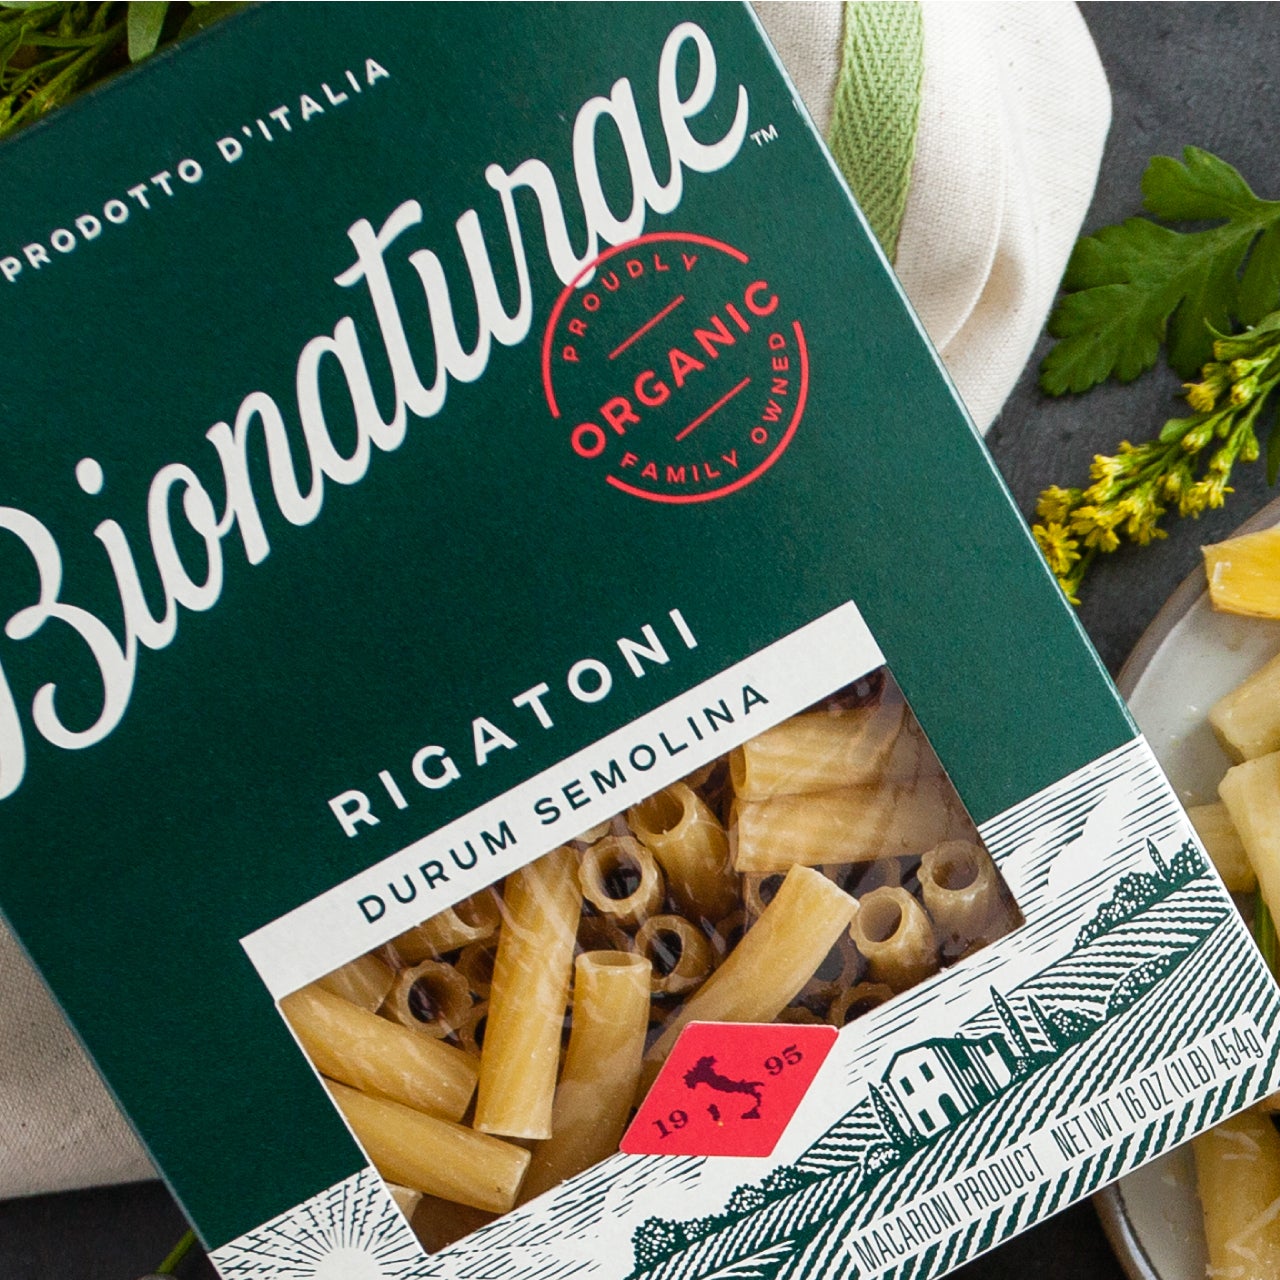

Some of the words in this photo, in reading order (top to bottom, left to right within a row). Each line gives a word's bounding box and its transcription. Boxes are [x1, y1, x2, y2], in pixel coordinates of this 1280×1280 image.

[0, 158, 203, 283] PRODOTTO
[216, 57, 391, 164] D'ITALIA
[0, 21, 749, 801] Bionaturae
[562, 253, 698, 363] PROUDLY
[571, 280, 779, 458] ORGANIC
[620, 449, 739, 484] FAMILY
[751, 333, 789, 444] OWNED
[327, 607, 700, 838] RIGATONI
[357, 819, 518, 925] DURUM
[532, 684, 770, 825] SEMOLINA
[652, 1110, 689, 1139] 19
[764, 1044, 803, 1076] 95
[852, 1191, 961, 1273] MACARONI
[954, 1144, 1045, 1218] PRODUCT
[1050, 1113, 1090, 1161] NET
[1088, 1099, 1126, 1140] WT
[1117, 1085, 1147, 1125] 16
[1139, 1071, 1174, 1111] OZ
[1166, 1045, 1215, 1099] (1LB)
[1212, 1027, 1264, 1076] 454g
